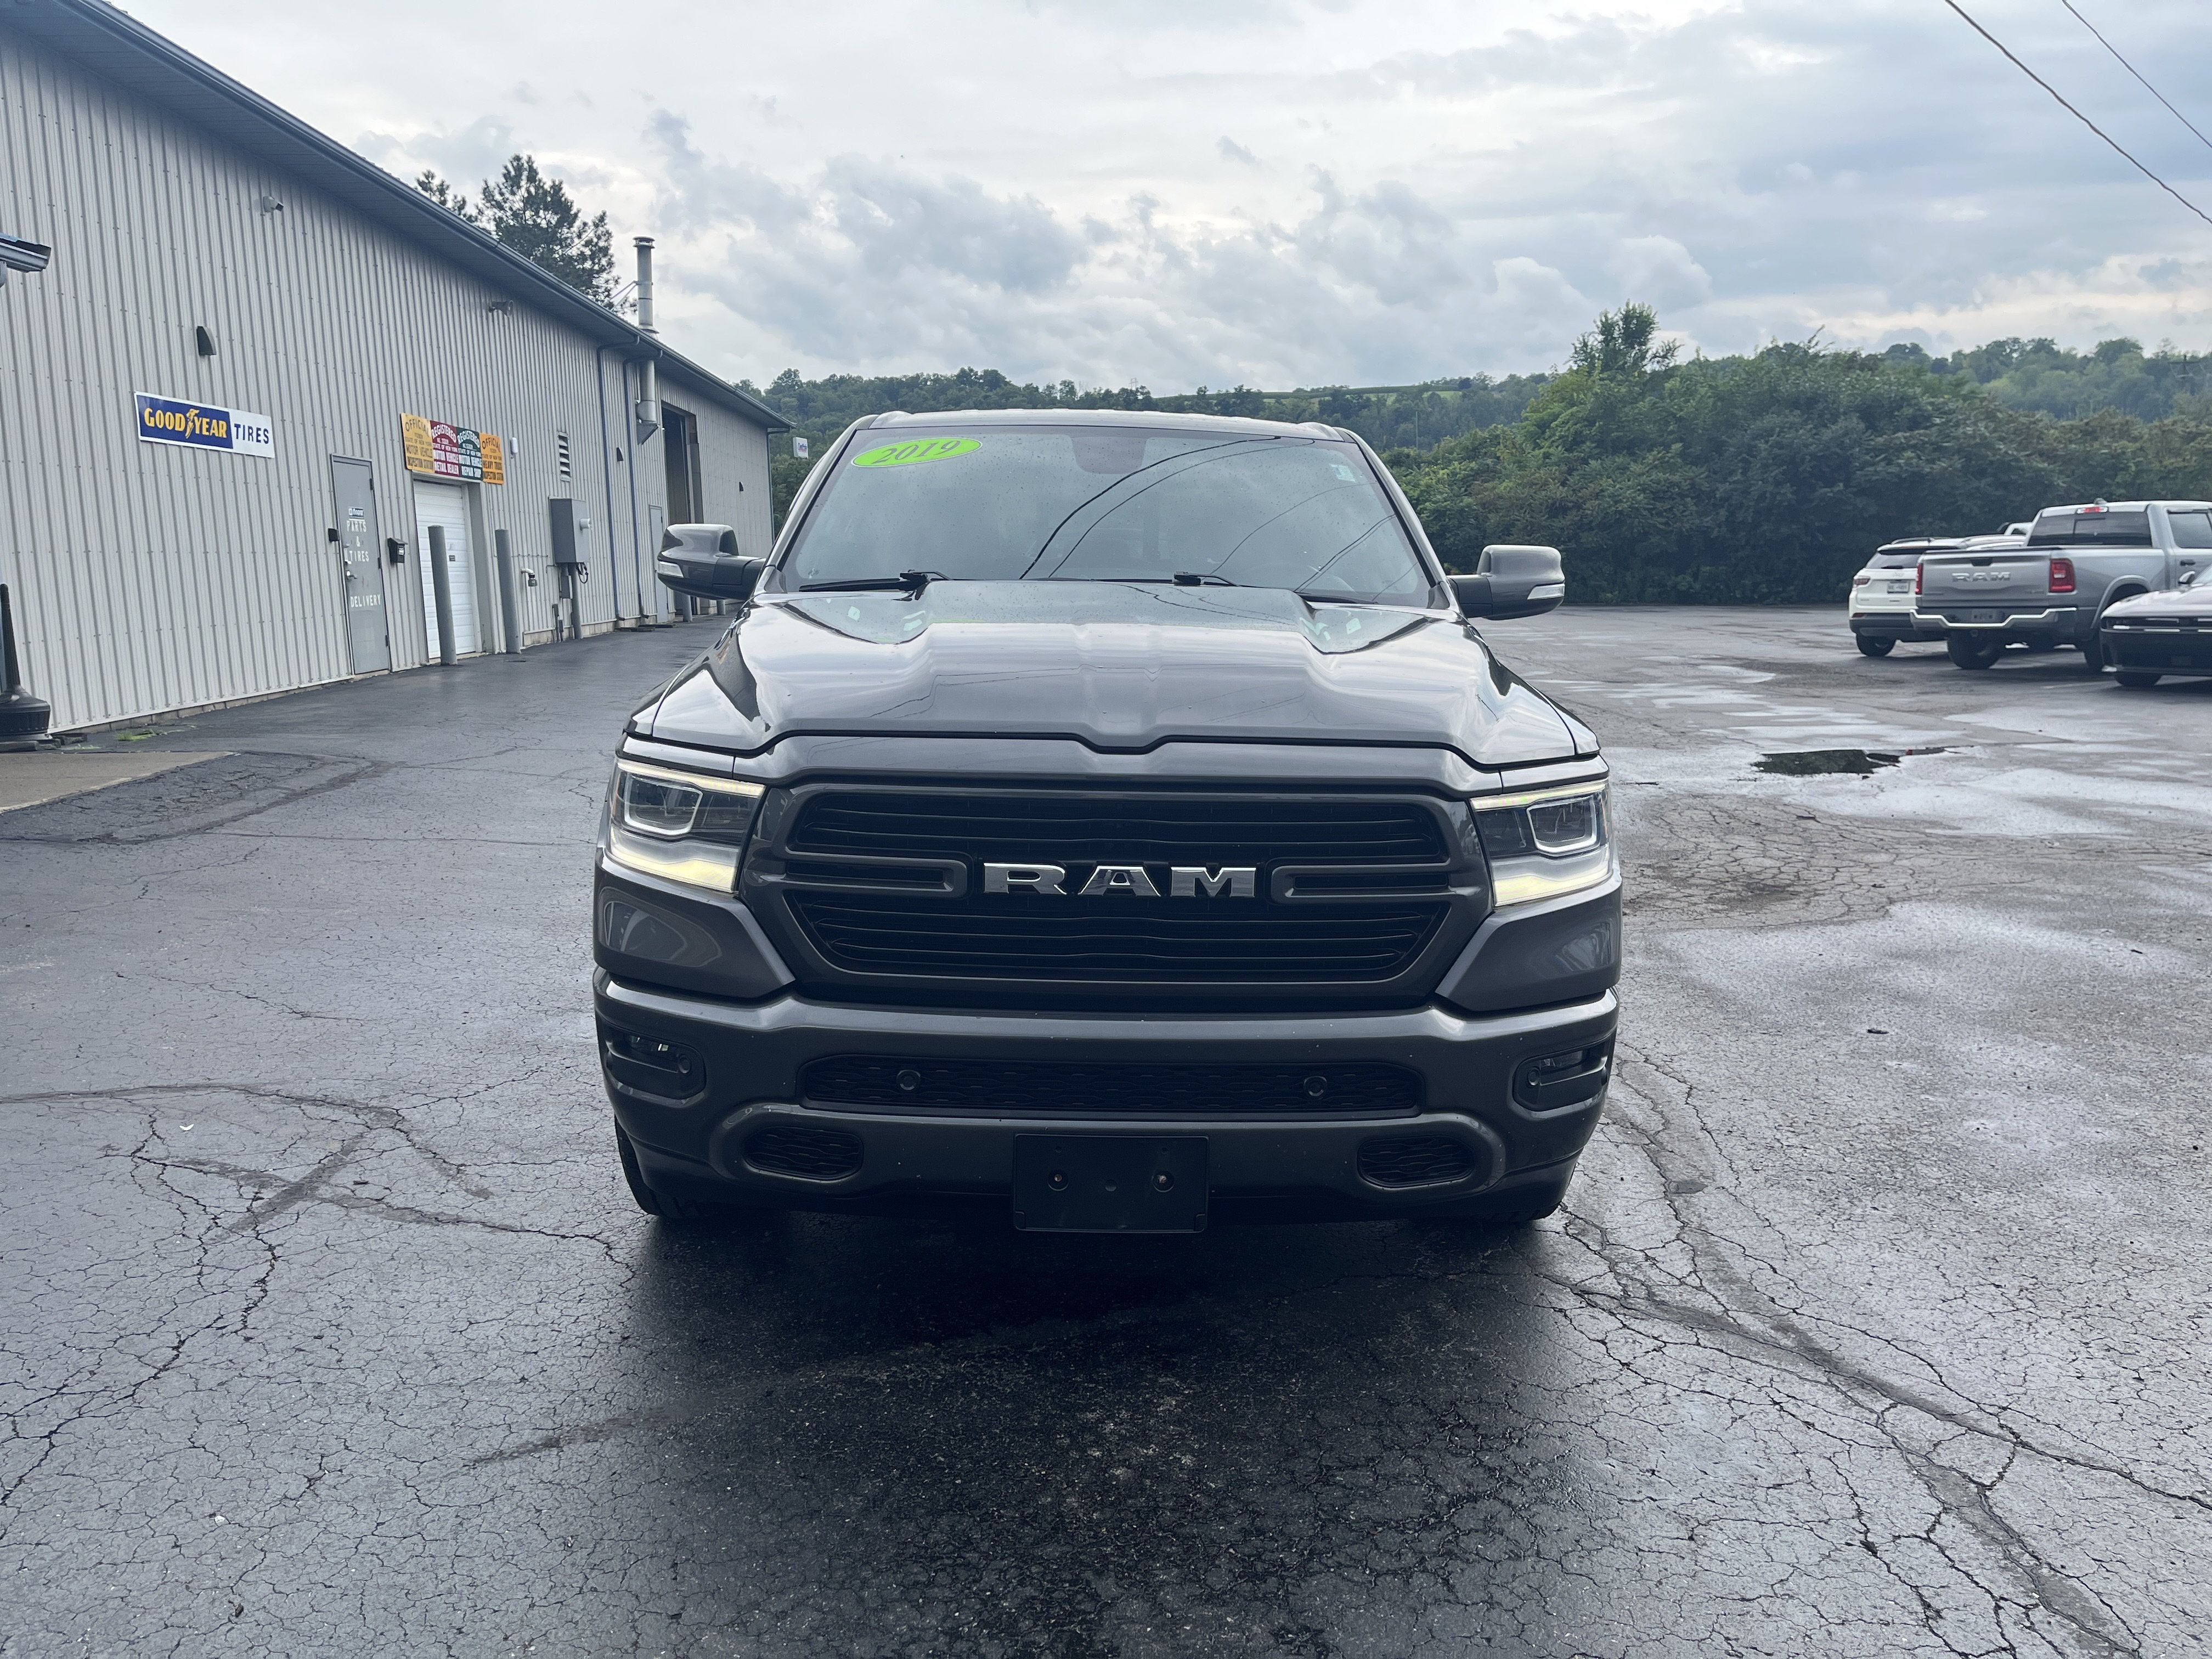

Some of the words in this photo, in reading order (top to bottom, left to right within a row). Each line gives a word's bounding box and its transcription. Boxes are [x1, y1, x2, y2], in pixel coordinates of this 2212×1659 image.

[144, 407, 227, 438] GOODYEAR
[234, 424, 269, 444] TIRES
[405, 419, 430, 438] OFFICIAL
[431, 424, 457, 443] REGISTERED
[457, 430, 480, 448] REGISTERED
[870, 440, 961, 465] 2019
[346, 520, 367, 533] PARTS
[356, 535, 361, 548] &
[349, 551, 370, 562] TIRES
[1951, 571, 2011, 582] RAM
[350, 594, 381, 608] DELIVERY
[983, 862, 1257, 898] RAM
